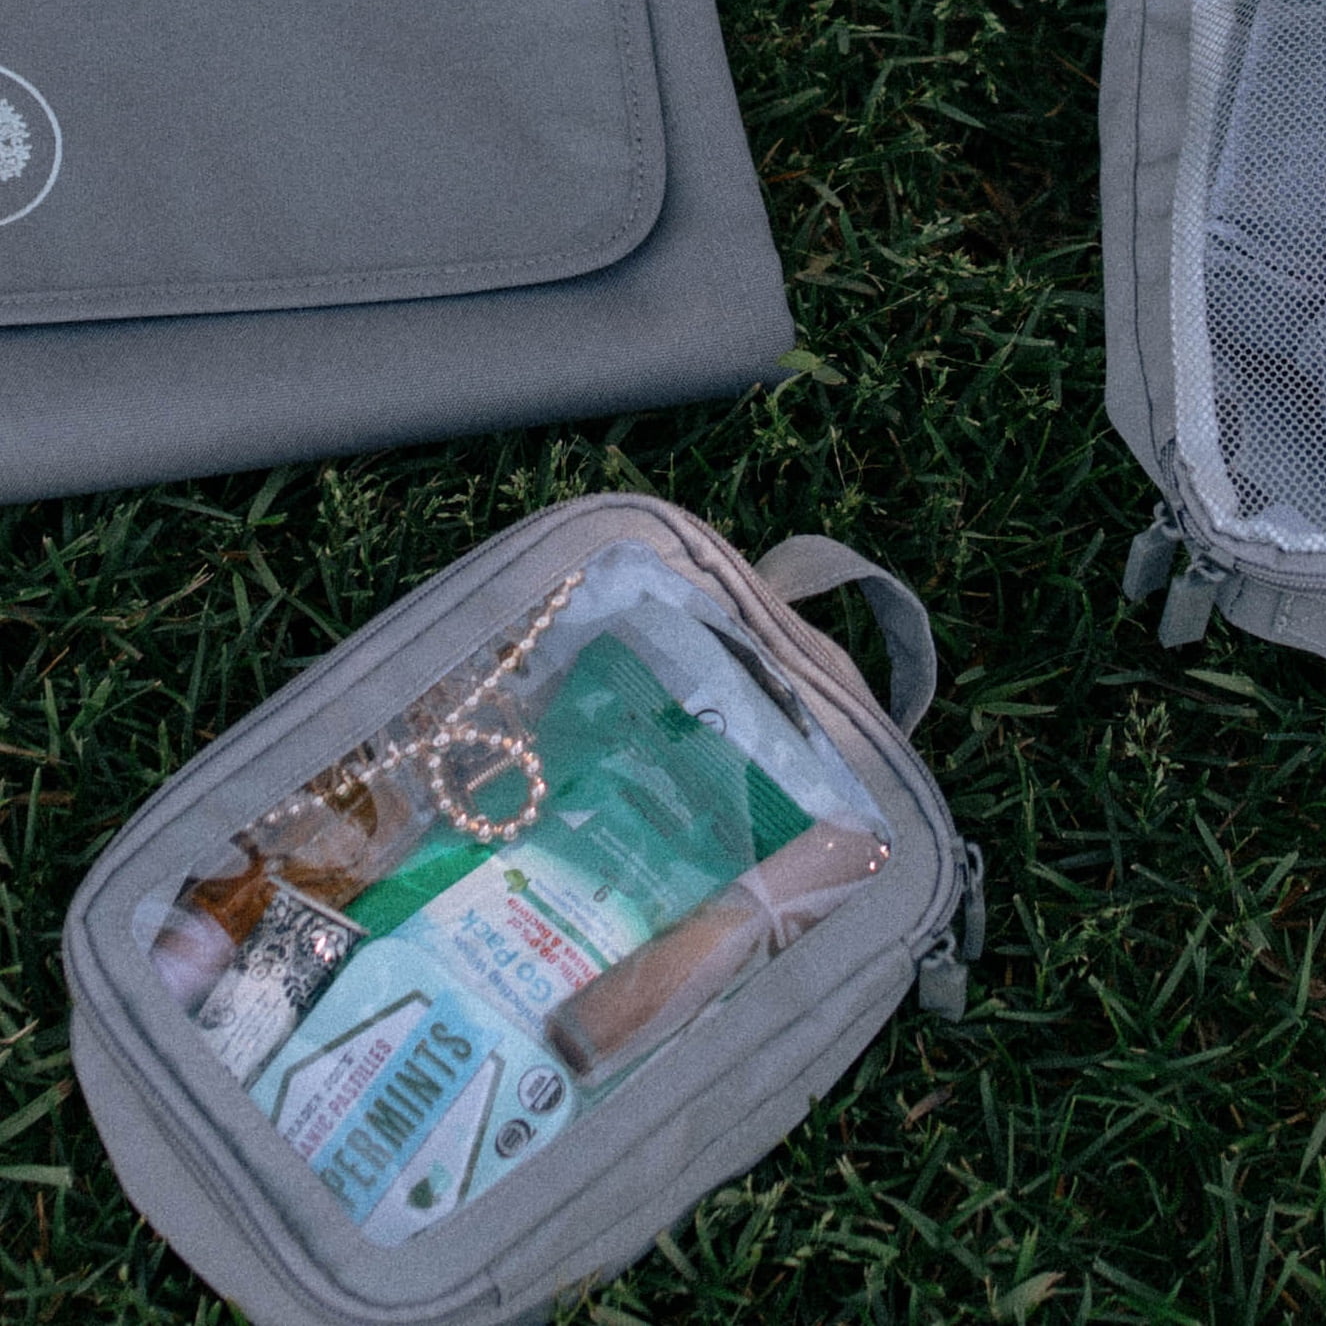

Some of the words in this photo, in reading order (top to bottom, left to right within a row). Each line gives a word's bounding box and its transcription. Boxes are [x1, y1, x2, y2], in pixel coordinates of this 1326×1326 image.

[460, 908, 519, 968] Pack
[506, 897, 552, 939] Bacteria
[516, 961, 553, 1003] Go
[300, 1113, 334, 1162] ANIC
[328, 1038, 393, 1119] PASTILLES
[320, 1021, 474, 1211] PERMINTS
